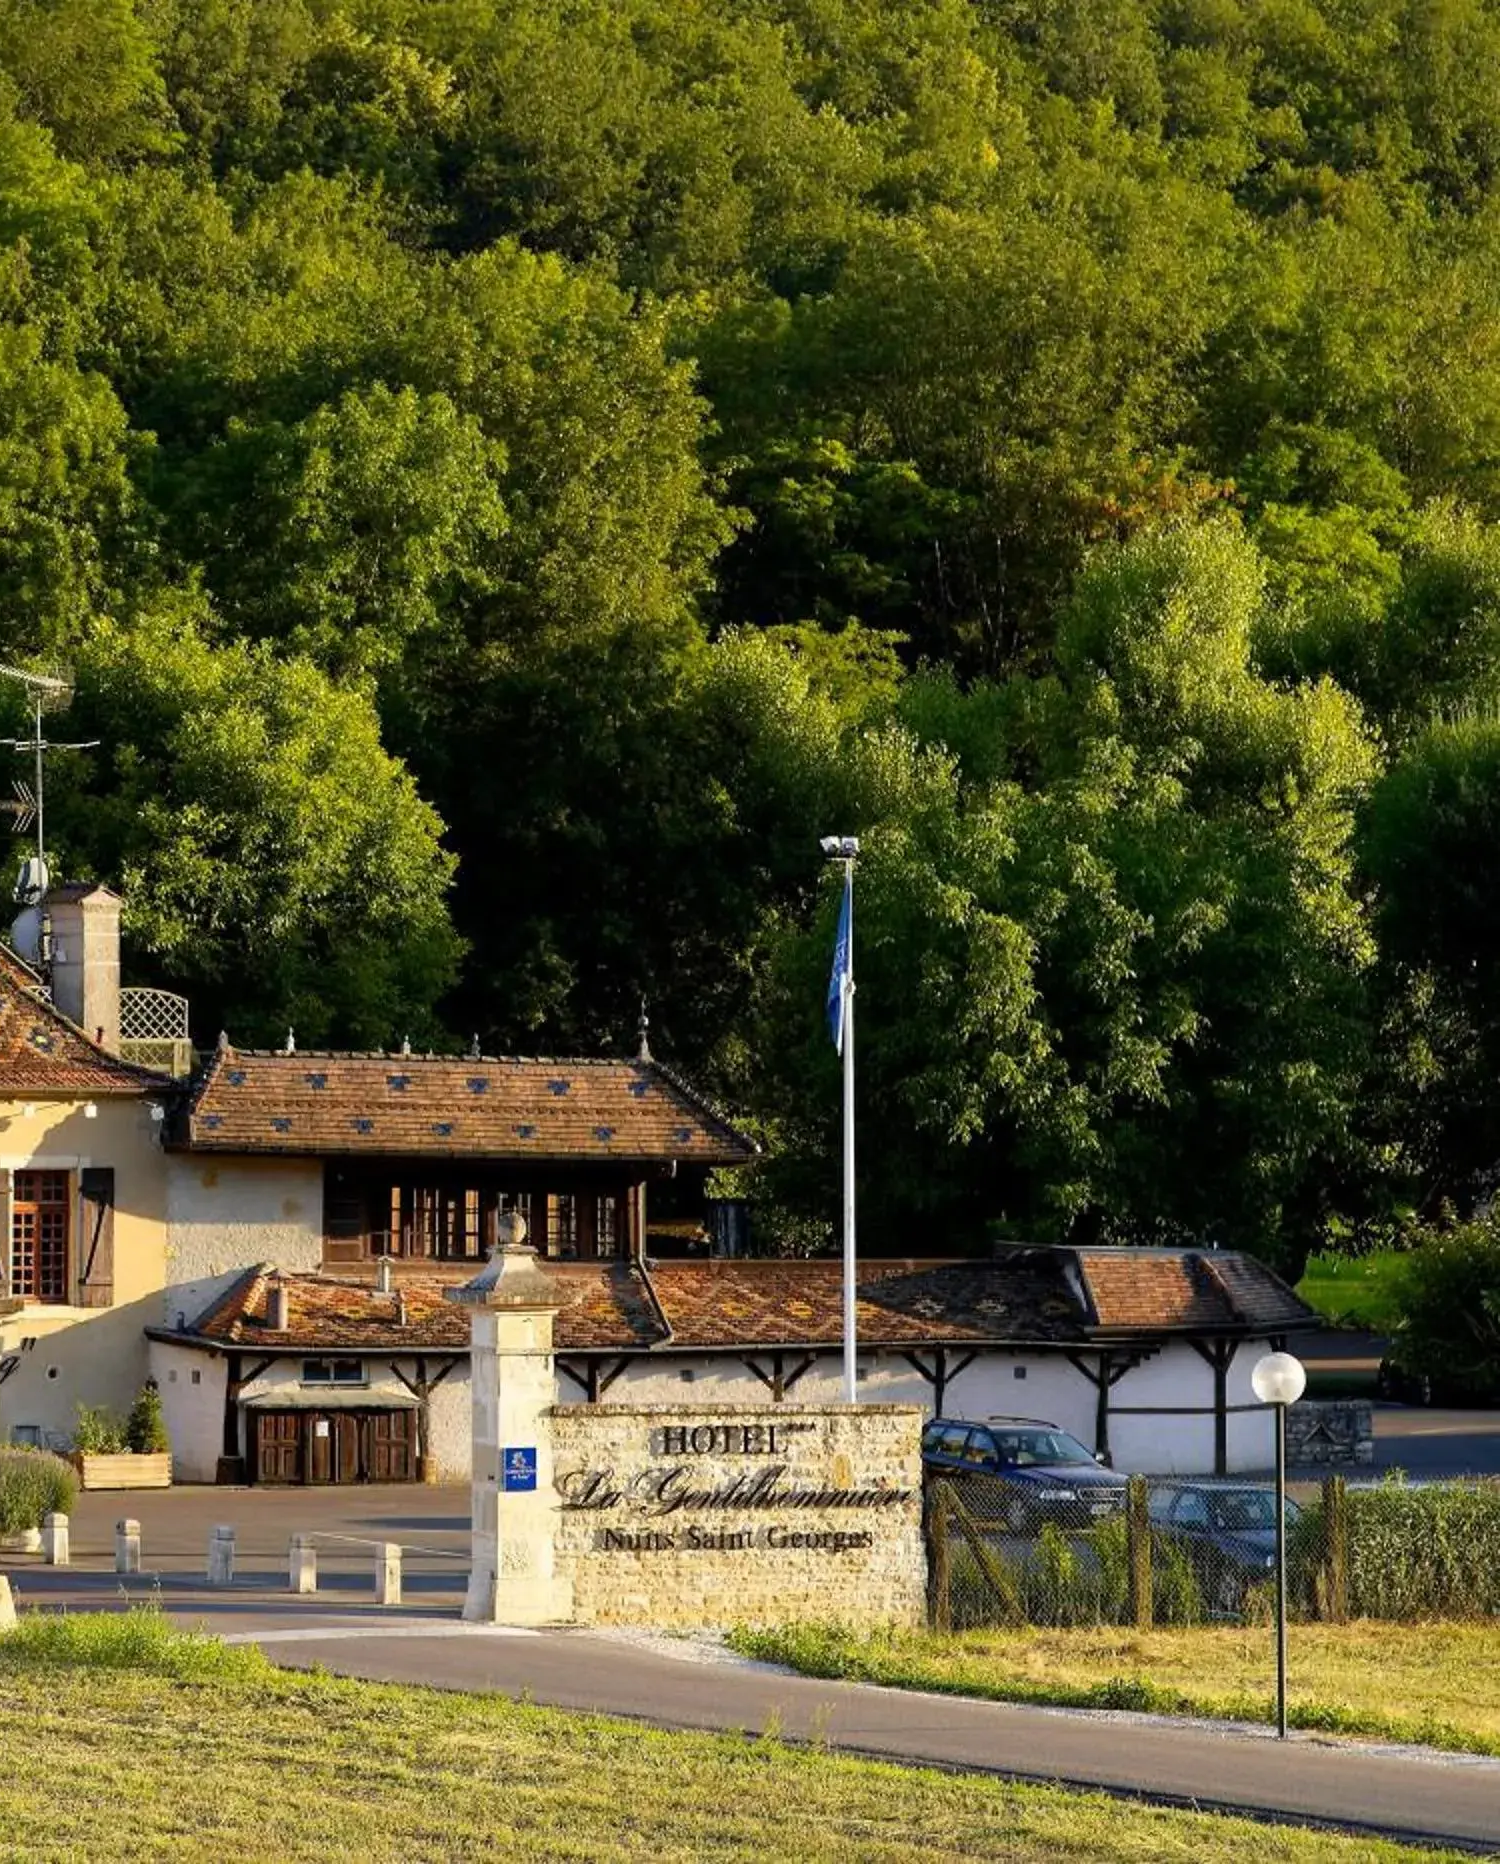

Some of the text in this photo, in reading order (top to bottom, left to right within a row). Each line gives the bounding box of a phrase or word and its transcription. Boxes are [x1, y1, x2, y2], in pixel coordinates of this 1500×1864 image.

[661, 1425, 789, 1454] HOTEL
[601, 1525, 874, 1552] Nuits Saint Georges
